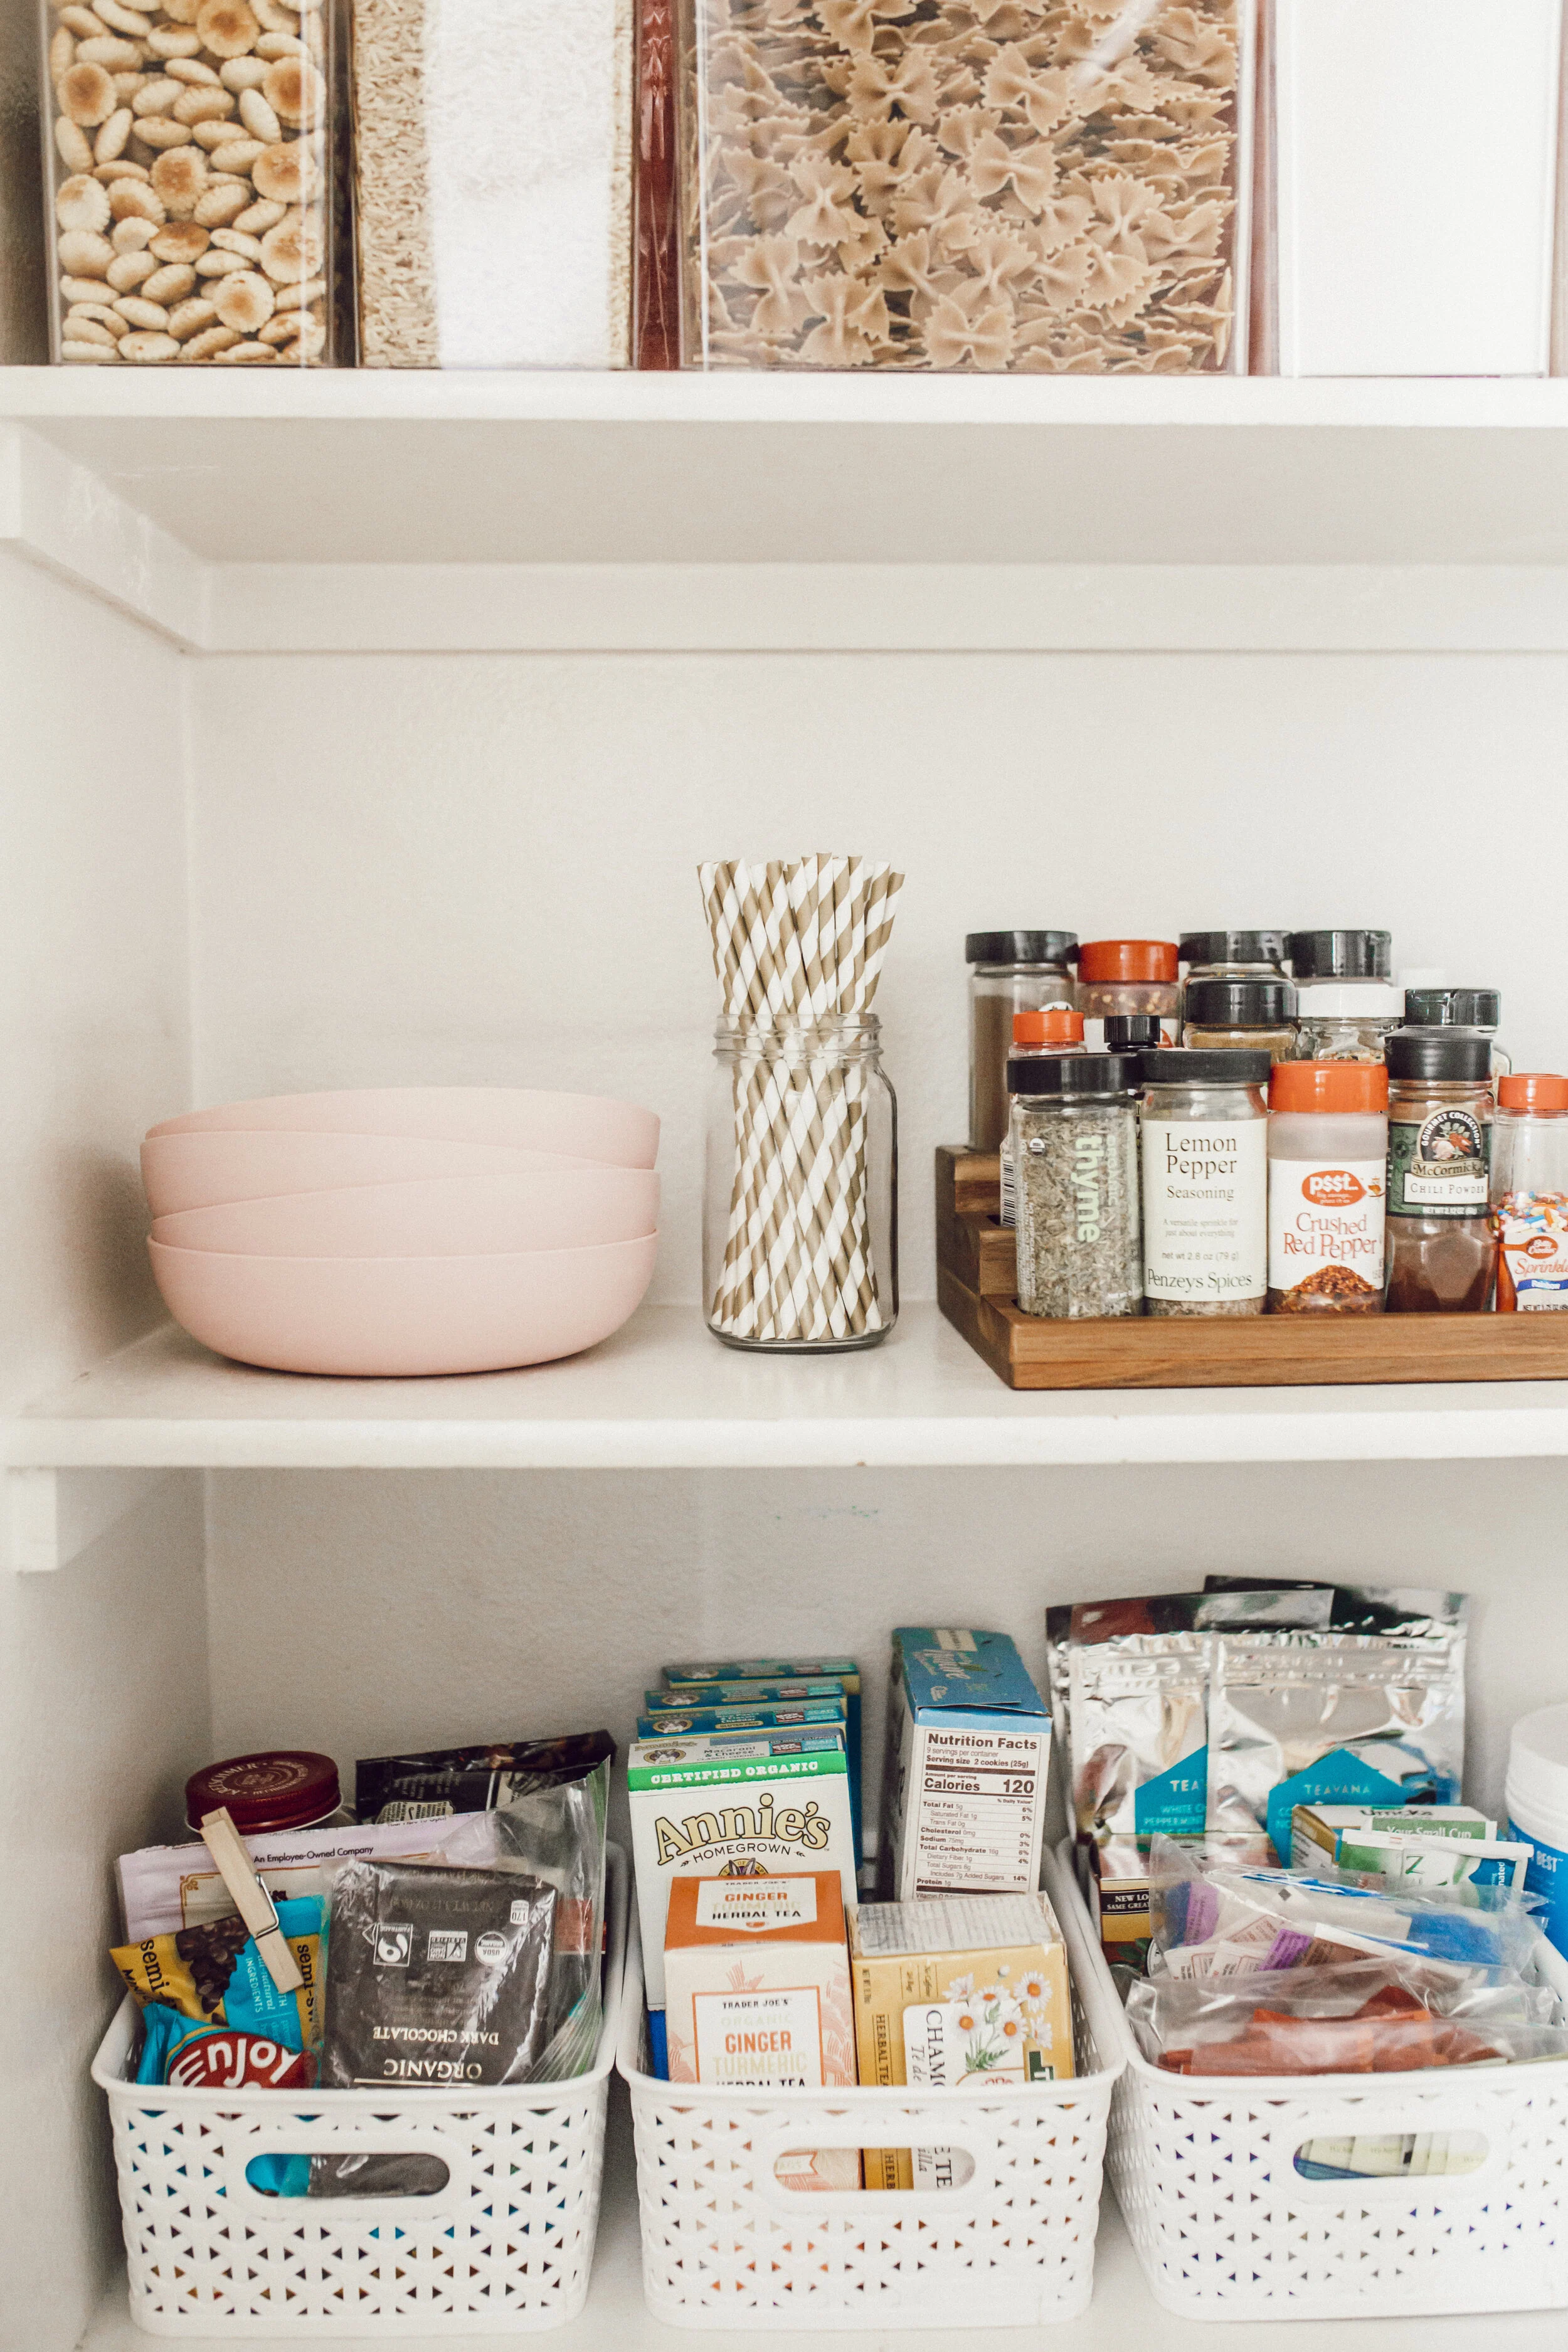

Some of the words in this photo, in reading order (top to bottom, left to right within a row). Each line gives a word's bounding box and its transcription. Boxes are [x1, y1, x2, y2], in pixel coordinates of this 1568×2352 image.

[1421, 1114, 1448, 1146] GOURMET
[1449, 1112, 1480, 1144] COLLECTION
[1165, 1133, 1237, 1152] Lemon
[1106, 1135, 1118, 1206] ORGANIC
[1167, 1155, 1237, 1179] Pepper
[1413, 1162, 1479, 1176] McCormick
[1071, 1136, 1104, 1243] thyme
[1167, 1185, 1234, 1201] Seasoning
[1296, 1212, 1367, 1235] Crushed
[1283, 1232, 1315, 1254] Red
[1320, 1233, 1377, 1261] Pepper
[1148, 1269, 1204, 1293] Penzeys
[1207, 1272, 1252, 1293] Spices
[928, 1733, 993, 1747] Nutrition
[998, 1737, 1037, 1749] Facts
[932, 1748, 958, 1756] servings
[926, 1755, 954, 1764] Serving
[1010, 1761, 1029, 1769] (25g)
[651, 1768, 741, 1784] CERTIFIED
[746, 1761, 818, 1777] ORGANIC
[924, 1777, 980, 1791] Calories
[1004, 1779, 1034, 1794] 120
[1304, 1784, 1371, 1795] TEAVANA
[655, 1793, 830, 1865] Annie's
[921, 1826, 961, 1835] Cholesterol
[1416, 1826, 1446, 1838] Small
[267, 1849, 335, 1863] Employee-Owned
[337, 1846, 374, 1860] Company
[693, 1843, 791, 1863] HOMEGROWN
[940, 1845, 987, 1853] Carbohydrate
[1537, 1850, 1558, 1873] BEST
[984, 1873, 1004, 1881] Sugars
[725, 1892, 787, 1902] GINGER
[511, 1912, 526, 1921] 170
[712, 1911, 767, 1920] HERBAL
[246, 1957, 263, 2013] INGREDIENTS
[279, 1992, 287, 2007] TH
[723, 2000, 758, 2010] TRADER
[763, 1999, 788, 2007] JOE'S
[373, 2026, 457, 2043] CHOCOLATE
[460, 2030, 499, 2045] DARK
[725, 2030, 792, 2054] GINGER
[876, 2014, 889, 2060] HERBAL
[384, 2058, 482, 2080] ORGANIC
[712, 2052, 808, 2077] TURMERIC
[913, 2067, 927, 2082] de
